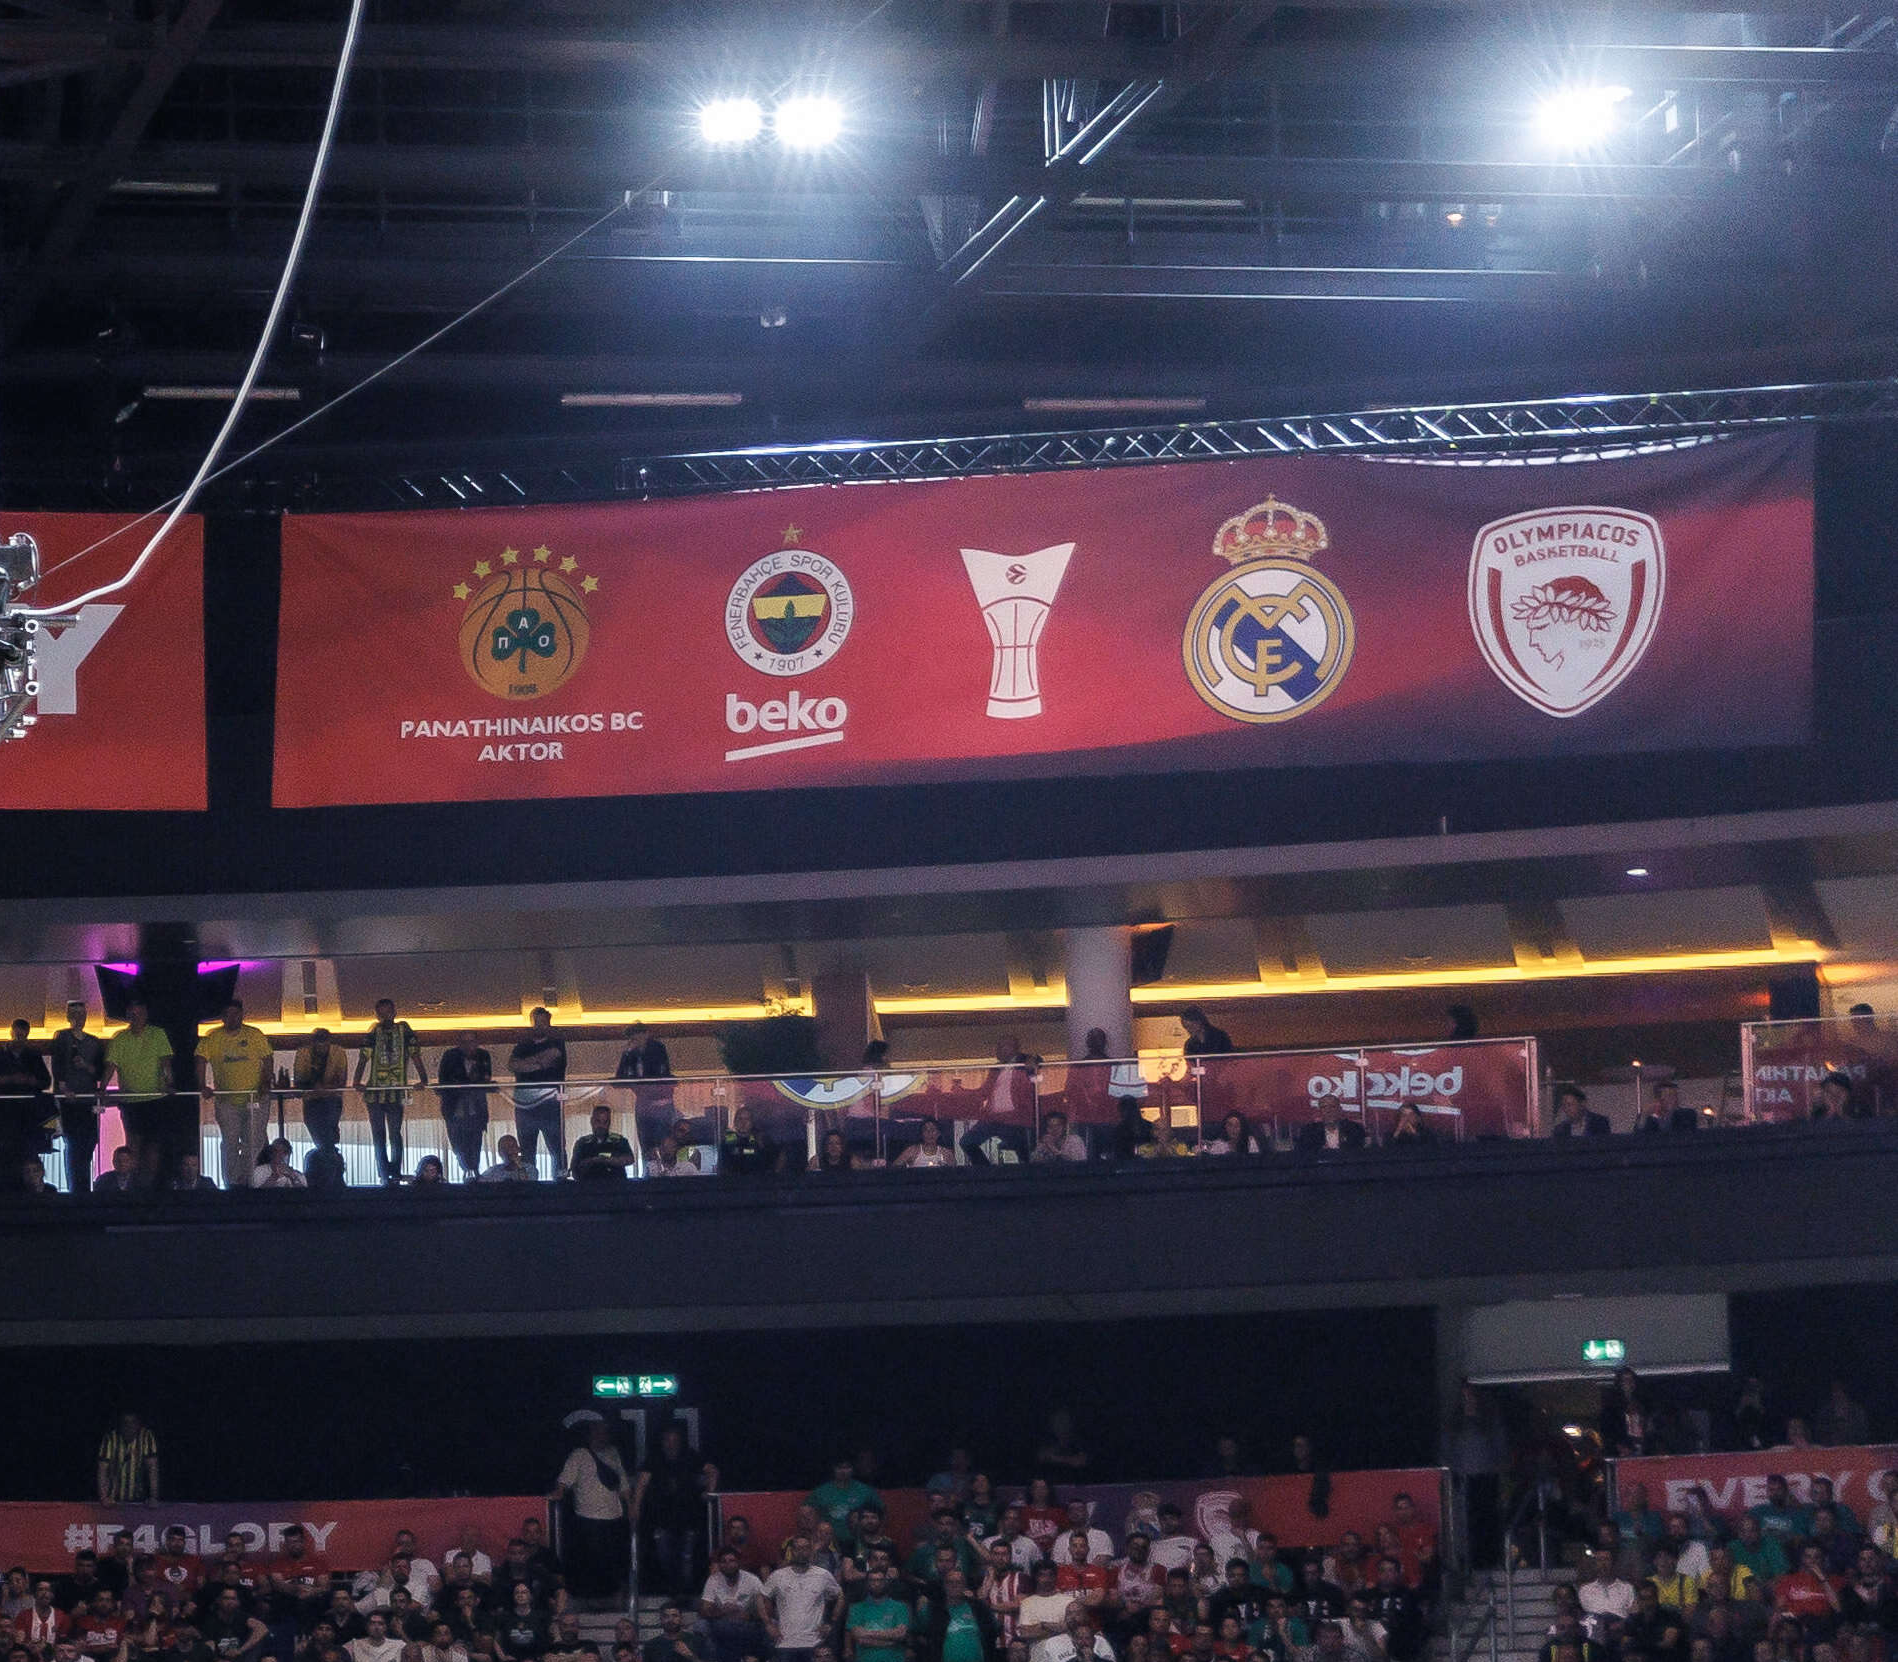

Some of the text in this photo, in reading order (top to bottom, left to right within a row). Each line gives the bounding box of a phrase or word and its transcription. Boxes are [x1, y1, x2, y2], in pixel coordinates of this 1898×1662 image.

[1493, 520, 1641, 557] OLYMPIACOS
[789, 553, 834, 580] SPOR
[1514, 544, 1621, 569] BASKETBALL
[767, 655, 806, 673] 1907
[399, 710, 644, 741] PANATHINAIKOS BC
[725, 691, 848, 734] beko
[477, 740, 565, 763] AKTOR
